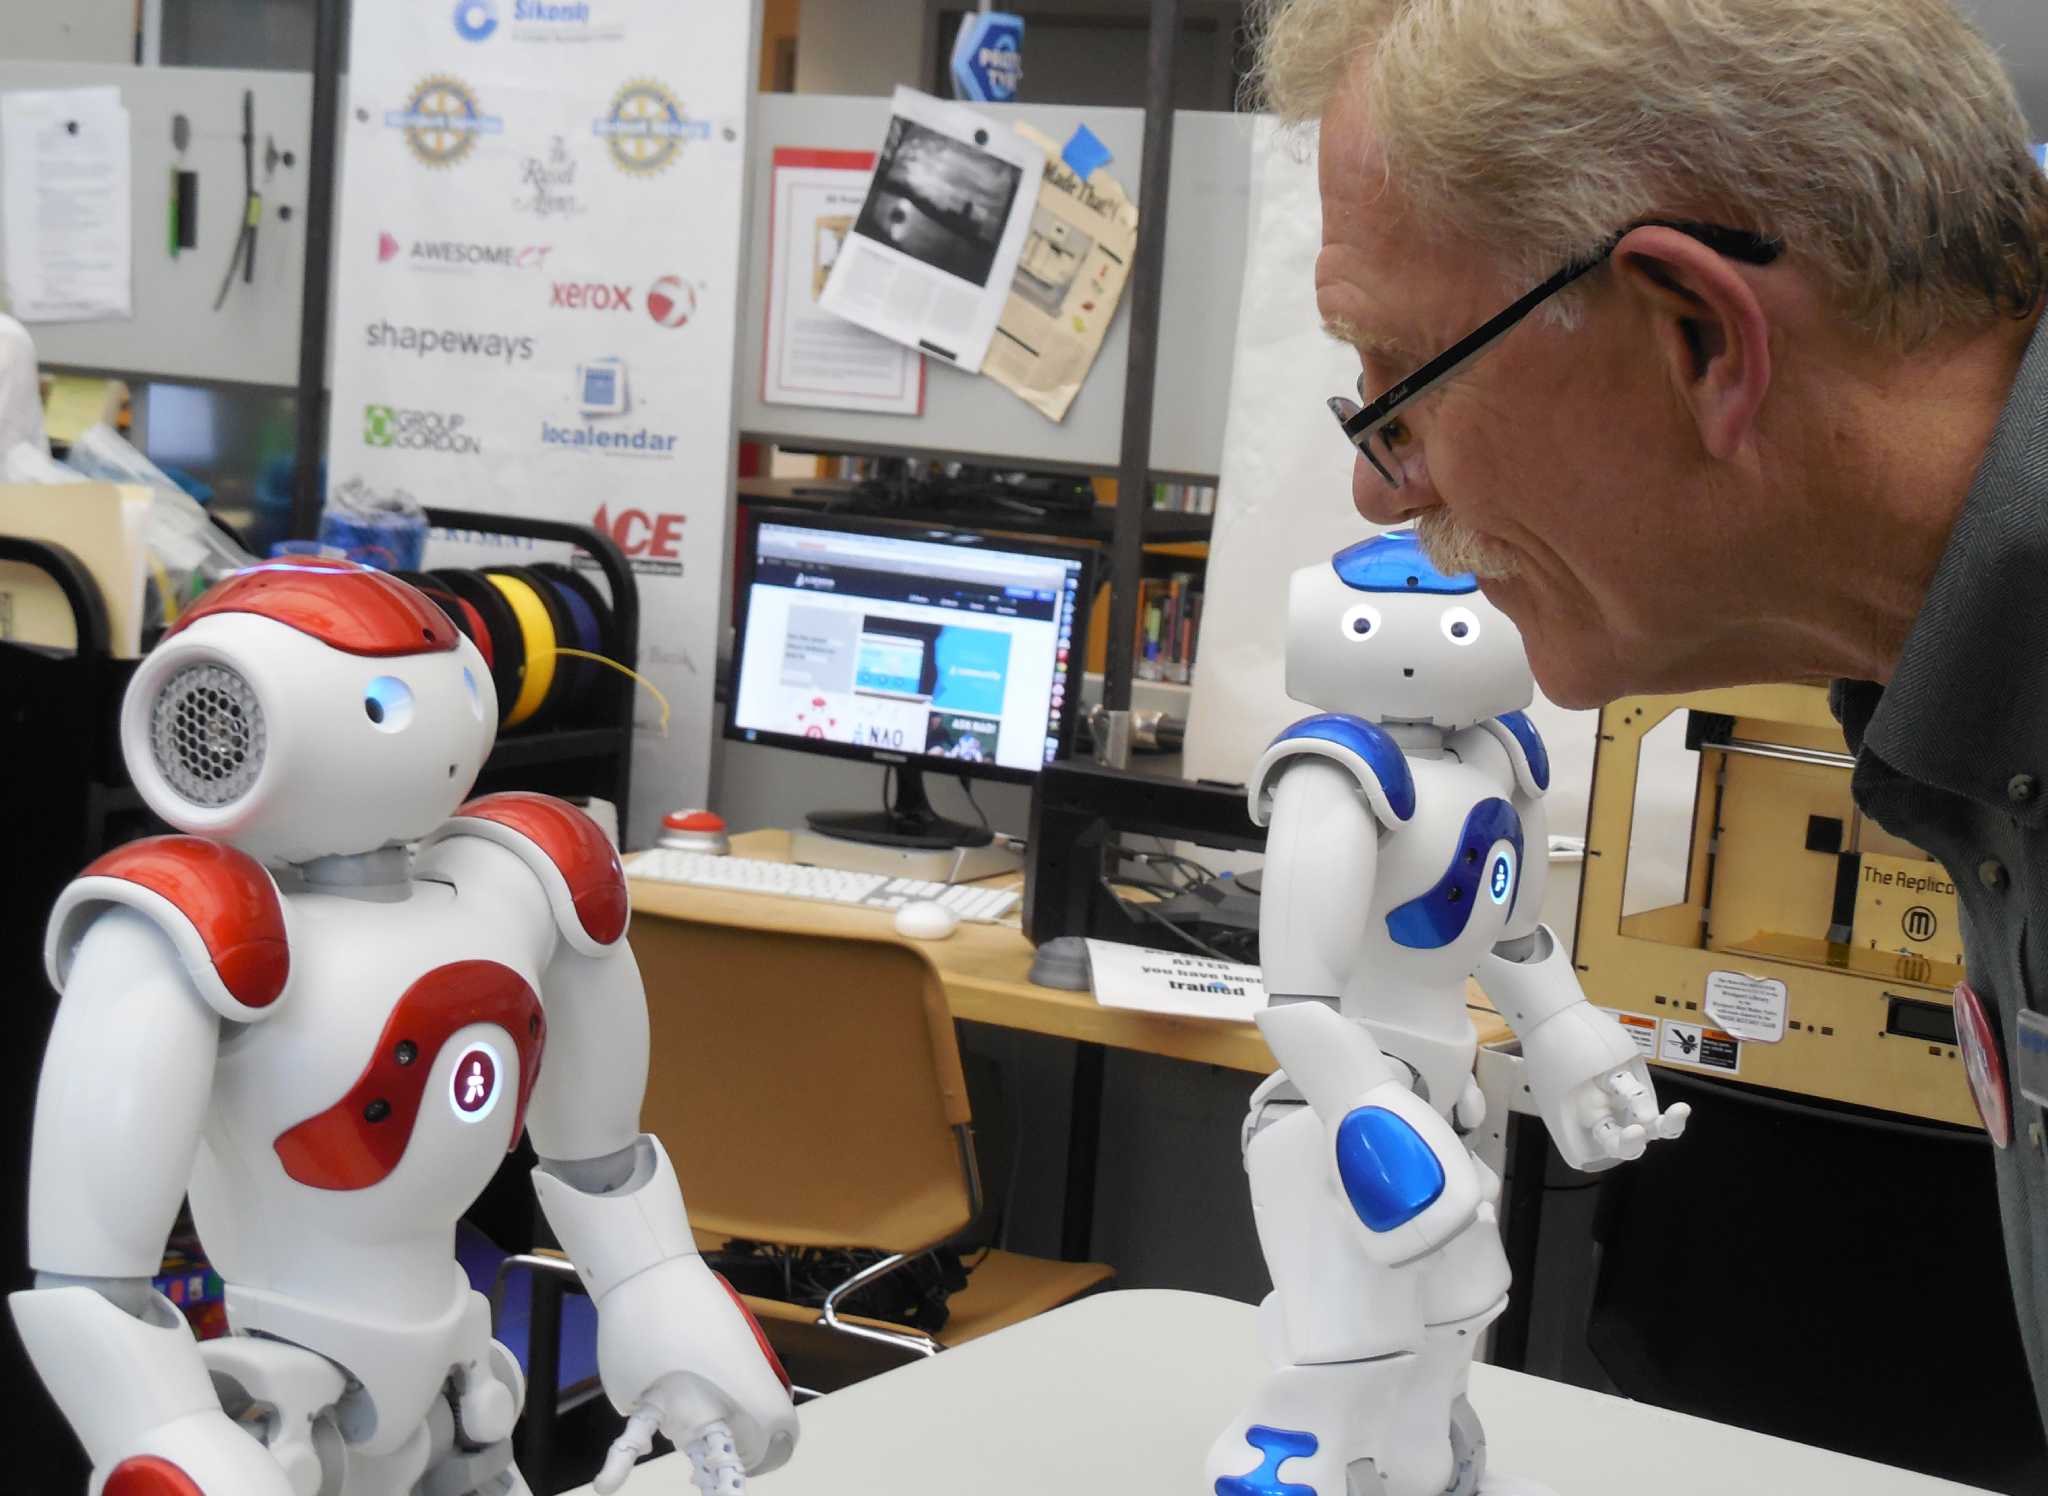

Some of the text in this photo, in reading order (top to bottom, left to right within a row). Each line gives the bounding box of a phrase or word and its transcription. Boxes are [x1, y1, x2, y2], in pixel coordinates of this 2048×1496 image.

[550, 281, 634, 313] xerox
[366, 321, 534, 363] shapeways
[399, 409, 465, 431] GROUP
[398, 432, 482, 455] GORDON
[542, 421, 677, 451] localendar
[1864, 866, 1893, 885] The
[1142, 965, 1173, 976] you
[1178, 968, 1218, 980] have
[1172, 958, 1229, 971] AFTER
[1170, 980, 1246, 995] trained
